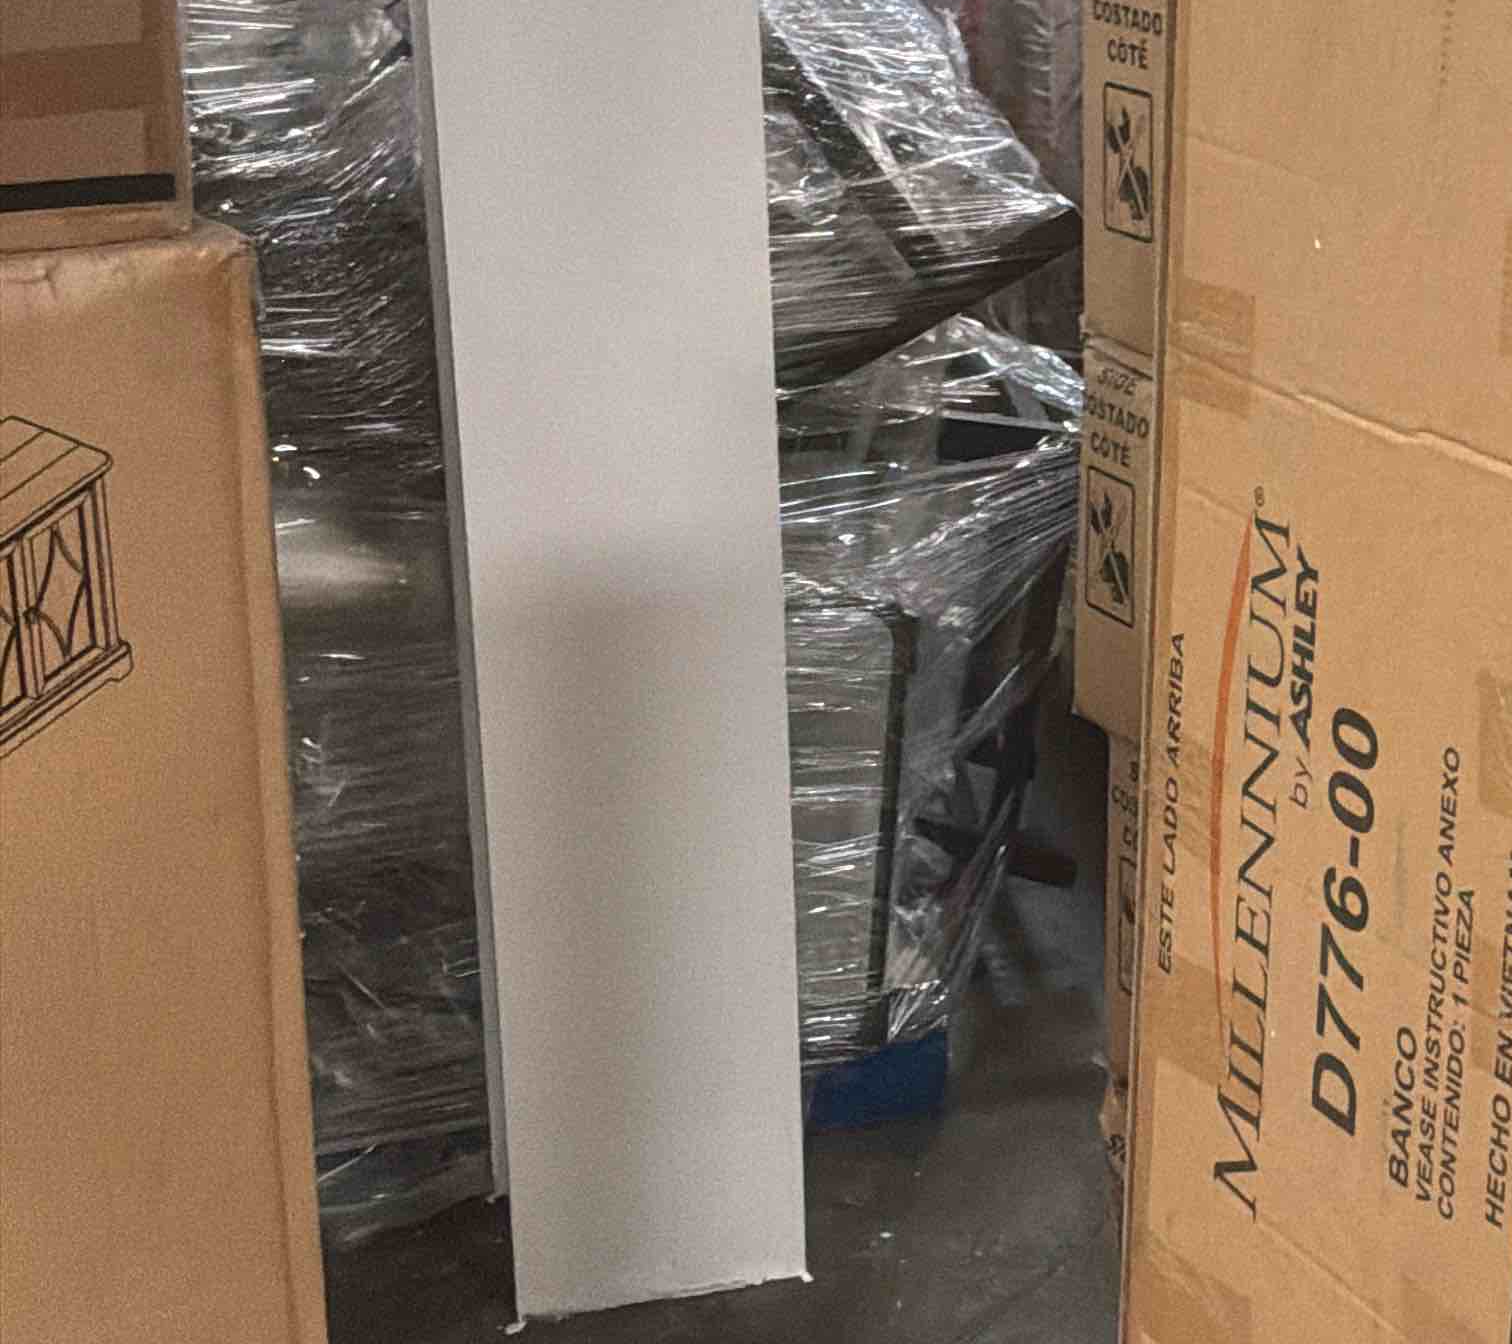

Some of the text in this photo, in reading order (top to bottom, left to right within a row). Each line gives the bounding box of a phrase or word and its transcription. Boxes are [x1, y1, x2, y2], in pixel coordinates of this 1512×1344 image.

[1092, 0, 1163, 37] COSTADO
[1086, 396, 1149, 438] OSTADO
[1158, 631, 1186, 975] ESTE LADO ARRIBA
[1289, 544, 1319, 808] by ASHLEY
[1310, 706, 1379, 1137] D776-00
[1415, 745, 1461, 1204] VEASE INSTRUCTIVO ANEXO
[1388, 1025, 1418, 1188] BANCO
[1436, 887, 1474, 1221] CONTENIDO: 1 PIEZA
[1484, 1095, 1512, 1230] HECHO
